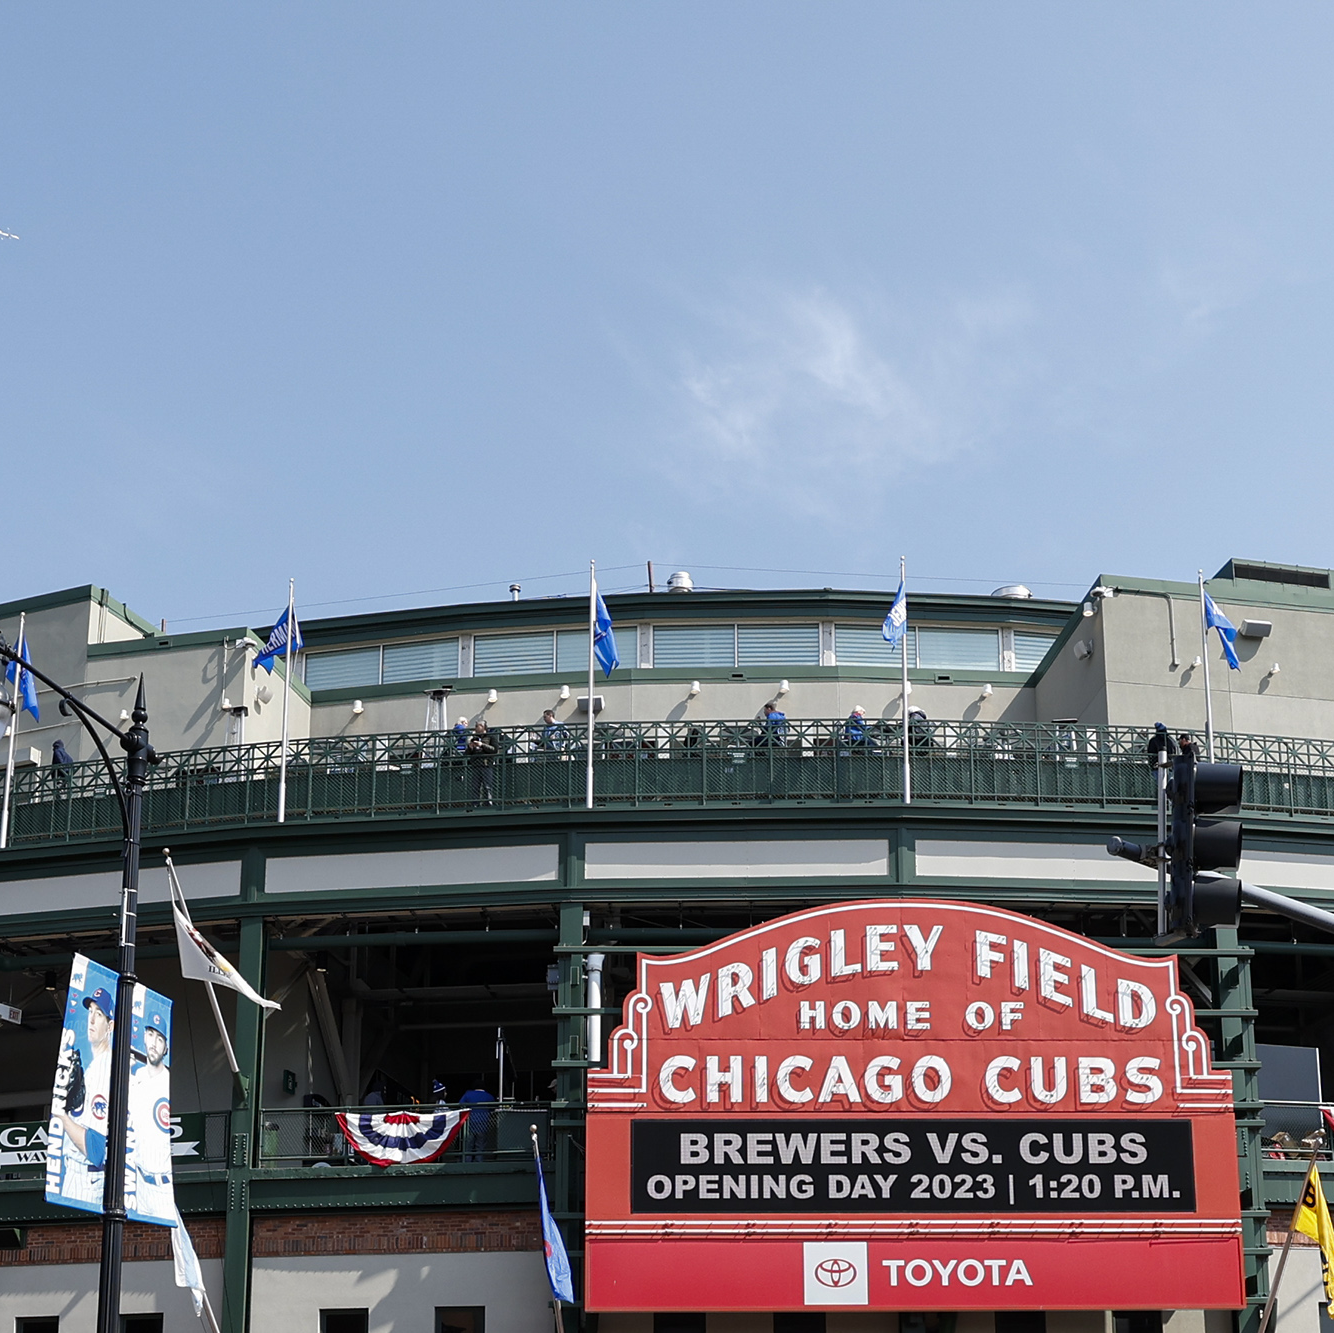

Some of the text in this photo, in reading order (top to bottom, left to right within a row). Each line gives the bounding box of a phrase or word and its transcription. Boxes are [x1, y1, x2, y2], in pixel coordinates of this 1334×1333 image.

[659, 924, 1158, 1029] WRIGLEY FIELD
[799, 1001, 1024, 1030] HOME OF
[659, 1055, 1164, 1104] CHICAGO CUBS
[45, 1027, 76, 1195] HENDRICKS
[679, 1132, 1148, 1165] BREWERS VS. CUBS
[646, 1173, 815, 1200] OPENING
[827, 1174, 899, 1199] DAY
[909, 1174, 996, 1199] 2023
[1029, 1174, 1102, 1199] 1:20
[1114, 1174, 1182, 1200] P.M.
[882, 1258, 1034, 1287] TOYOTA
